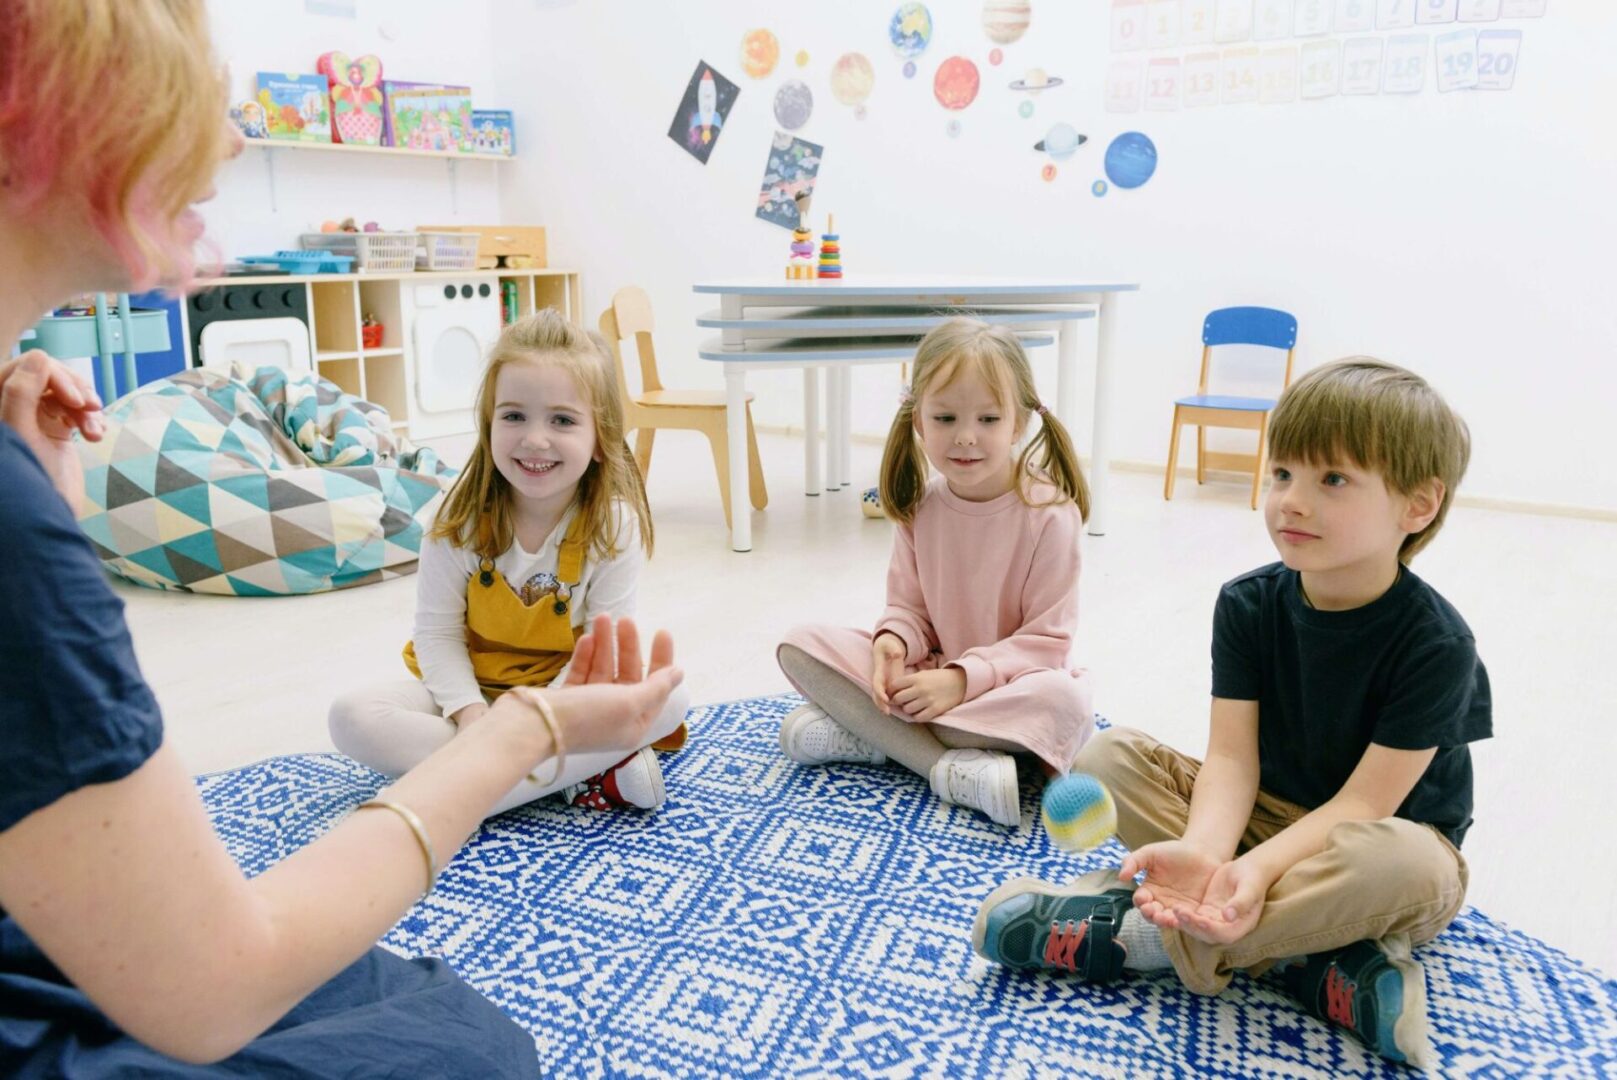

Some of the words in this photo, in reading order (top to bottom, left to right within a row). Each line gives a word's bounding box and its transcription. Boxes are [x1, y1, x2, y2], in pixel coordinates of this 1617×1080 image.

[1119, 18, 1136, 40] 0
[1157, 14, 1169, 35] 1
[1191, 8, 1206, 33] 2
[1305, 62, 1333, 85] 16
[1346, 59, 1377, 81] 17
[1390, 56, 1421, 79] 18
[1443, 52, 1474, 77] 19
[1478, 52, 1514, 75] 20
[1150, 77, 1176, 98] 12
[1188, 73, 1214, 95] 13
[1225, 67, 1256, 90] 14
[1110, 81, 1136, 100] 11
